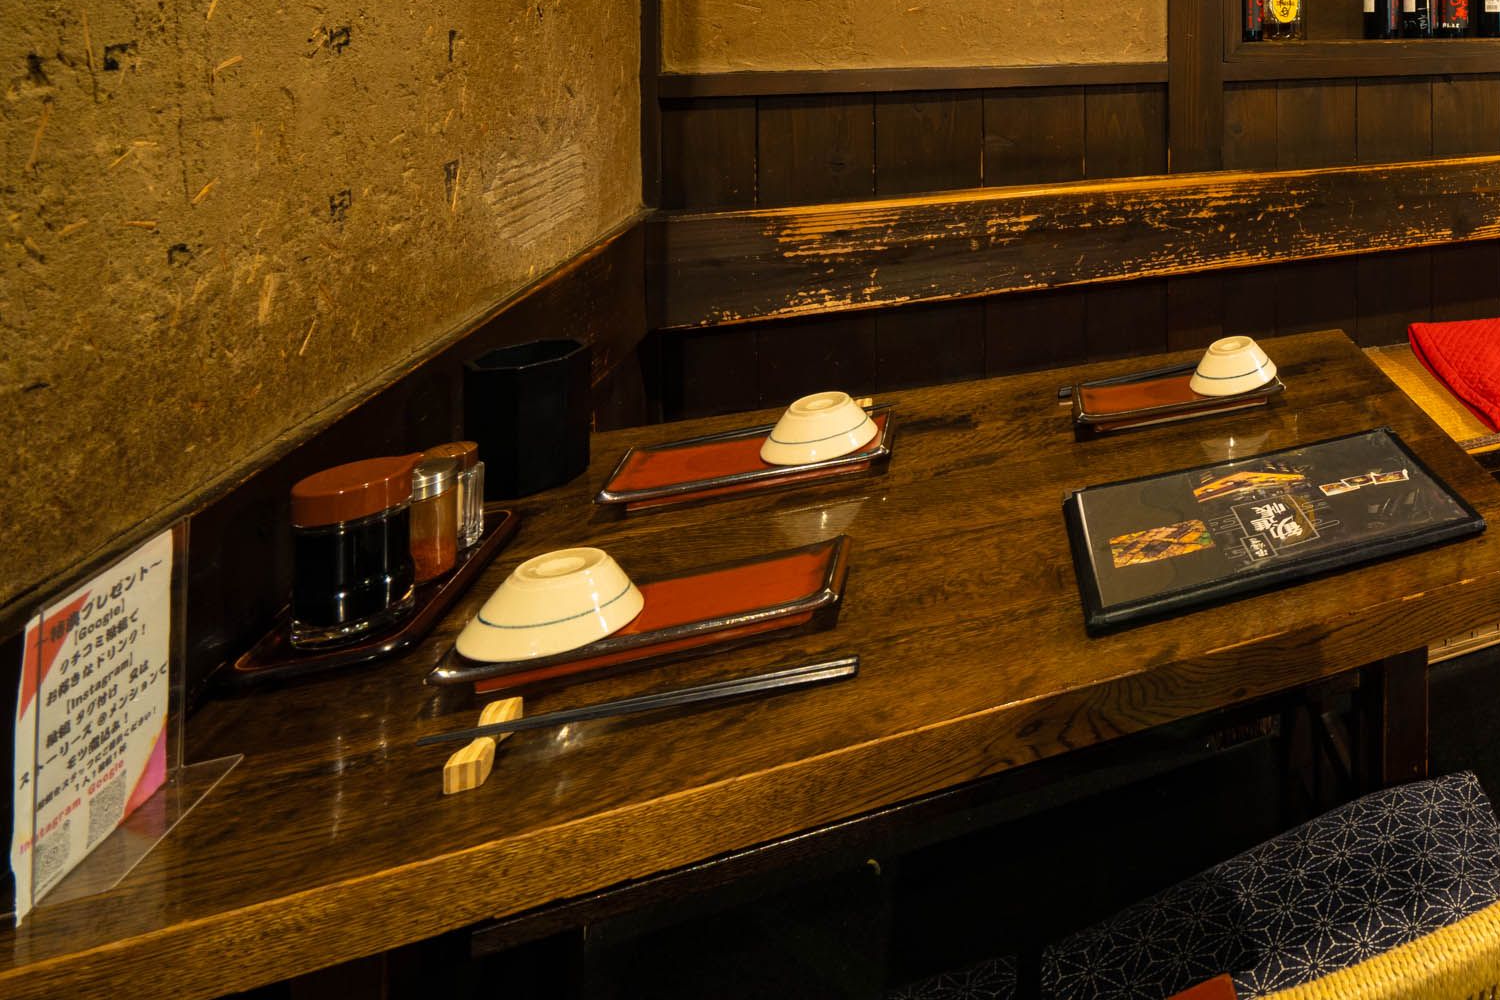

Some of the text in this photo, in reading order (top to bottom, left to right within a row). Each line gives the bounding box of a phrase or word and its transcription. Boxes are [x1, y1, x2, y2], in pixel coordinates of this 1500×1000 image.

[74, 598, 125, 646] [Google]
[66, 652, 133, 714] [Instagram]
[87, 759, 125, 797] Google
